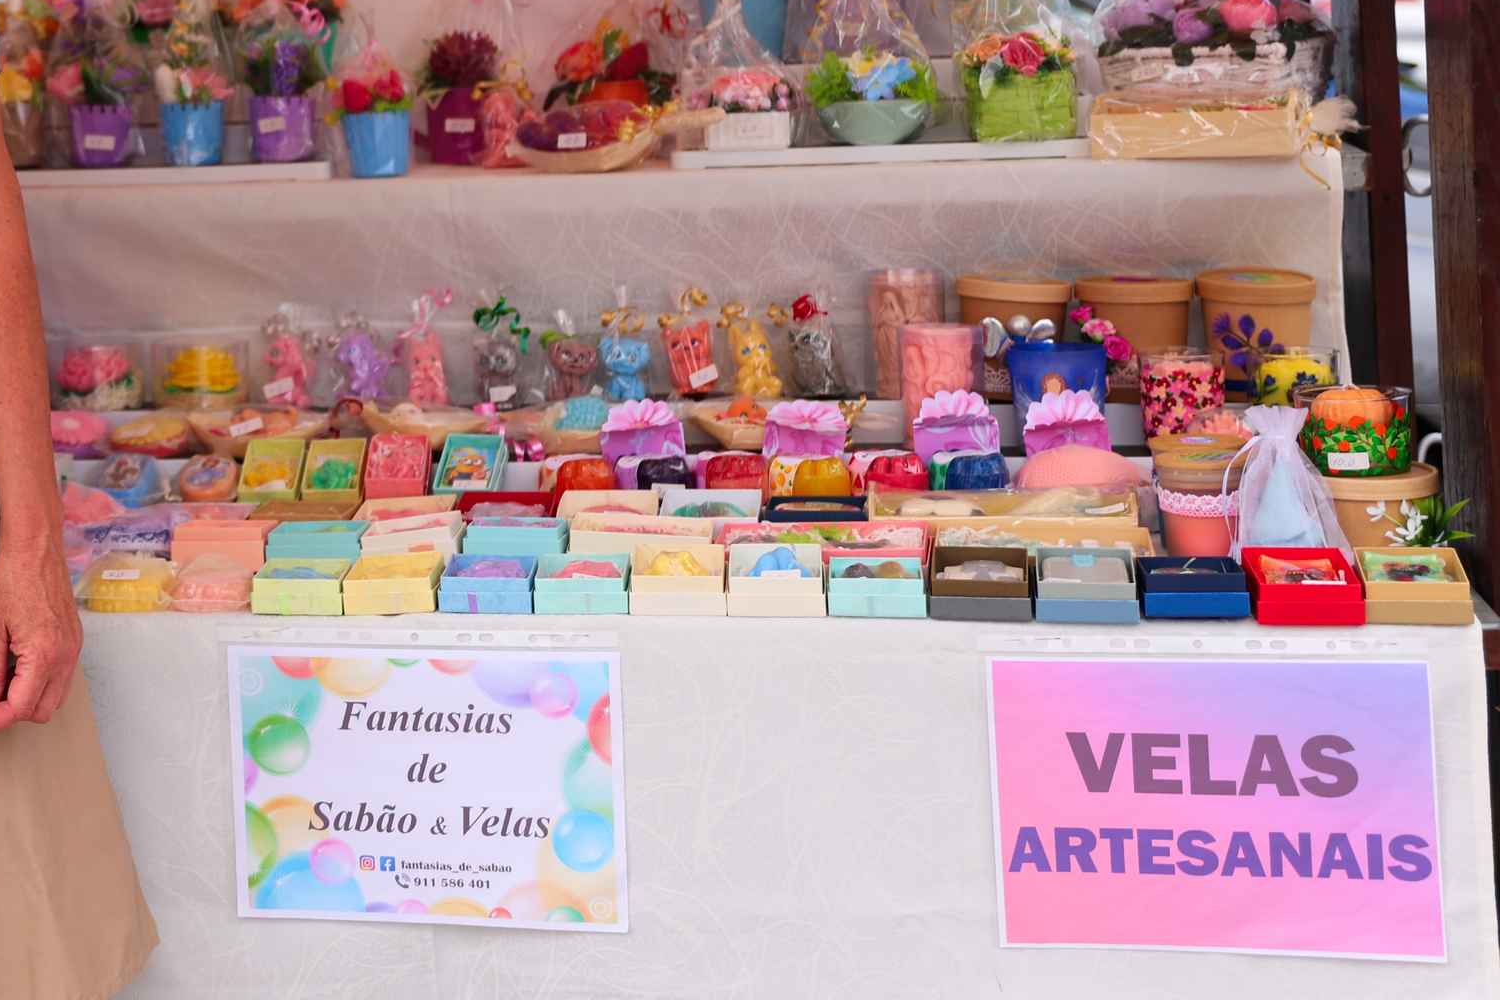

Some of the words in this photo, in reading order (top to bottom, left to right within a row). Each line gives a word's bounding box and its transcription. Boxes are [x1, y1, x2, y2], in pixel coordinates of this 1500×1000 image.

[337, 700, 514, 736] Fantasias
[406, 753, 448, 784] de
[1065, 731, 1359, 798] VELAS
[307, 800, 418, 835] Sabão
[429, 816, 449, 837] &
[459, 806, 551, 840] Velas
[400, 860, 512, 874] fantasias_de_sabao
[1008, 826, 1433, 882] ARTESANAIS
[413, 877, 436, 888] 911
[441, 878, 465, 889] 586
[468, 879, 491, 889] 401
